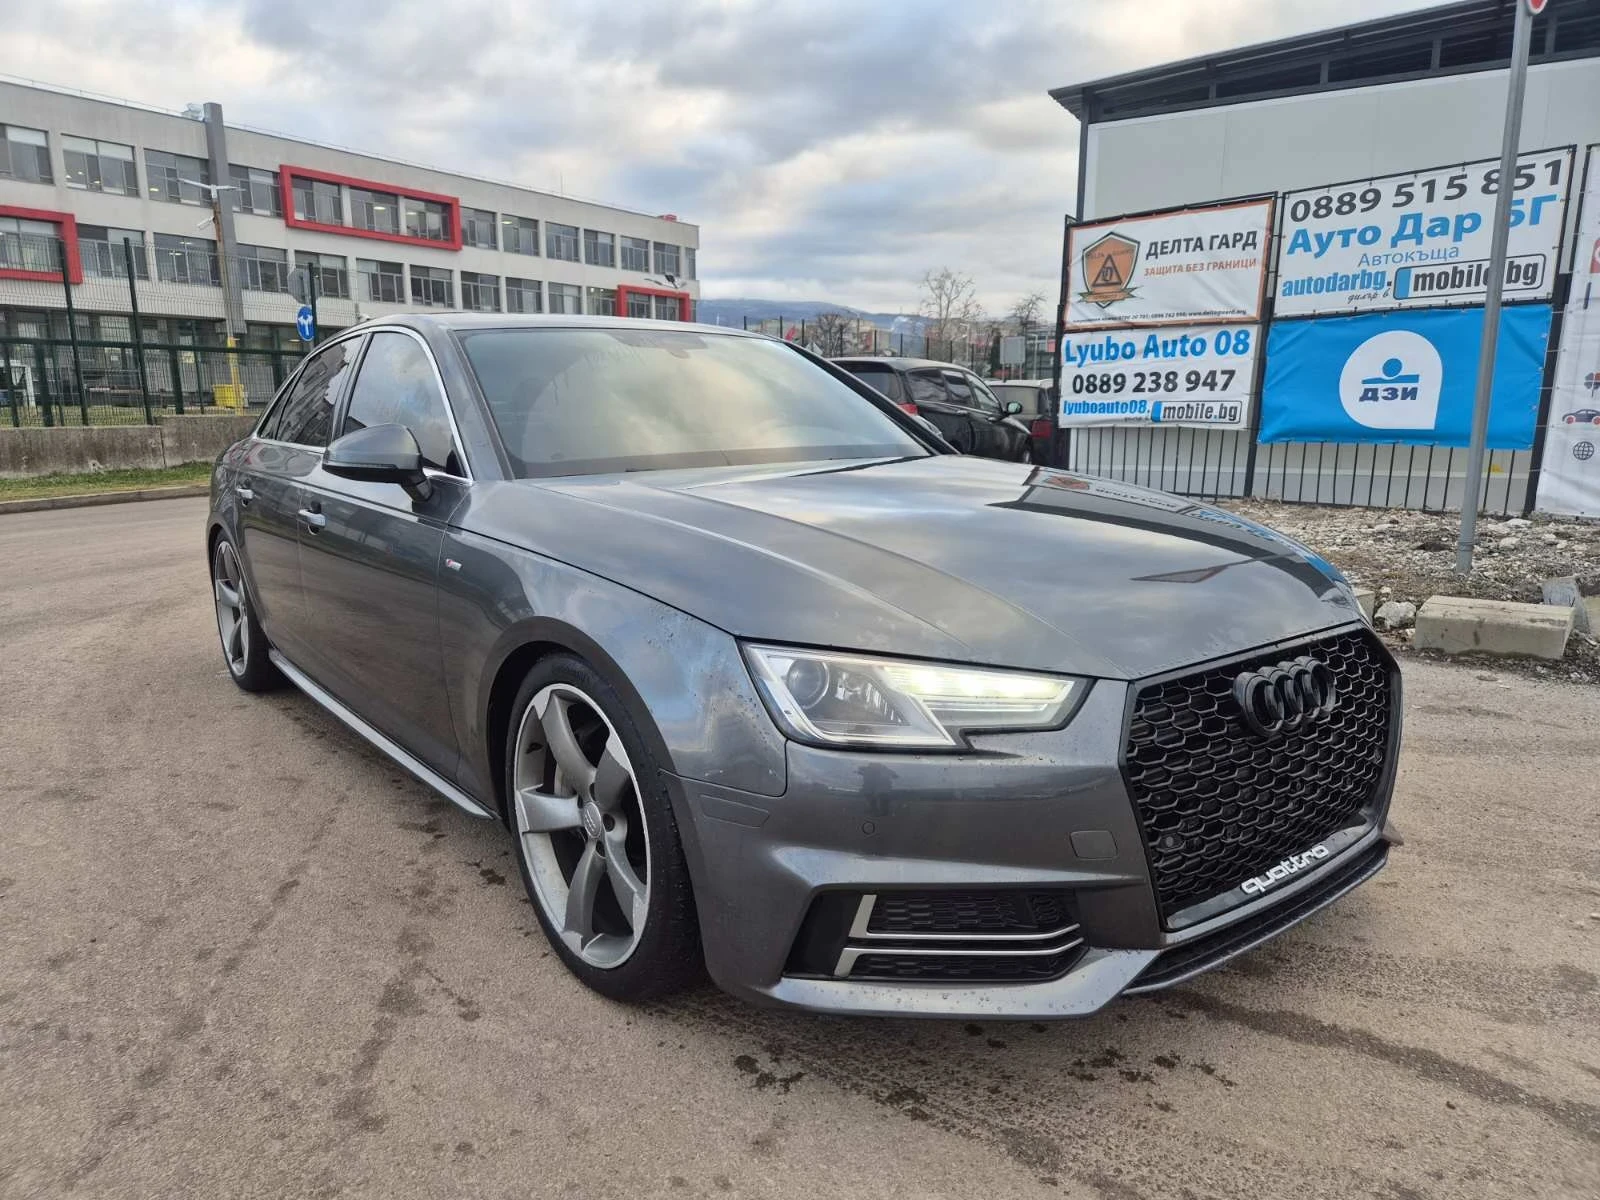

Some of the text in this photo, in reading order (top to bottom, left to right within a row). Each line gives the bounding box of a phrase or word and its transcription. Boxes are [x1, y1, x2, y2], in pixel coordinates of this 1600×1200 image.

[1290, 159, 1562, 222] 0889 515 851
[1145, 230, 1257, 260] ДЕЛТА ГАРД
[1286, 224, 1381, 258] Ауто
[1390, 212, 1482, 248] Дар
[1144, 258, 1257, 277] ЗАЩИТА БЕЗ ГРАНИЦИ
[1357, 246, 1460, 268] Автокъща
[1282, 260, 1539, 296] autodarbg. mobilebg
[1065, 329, 1251, 368] Lyubo Auto 08
[1072, 369, 1236, 394] 0889 238 947
[1358, 386, 1419, 402] ДЗИ
[1162, 402, 1239, 422] mobile.bg
[1241, 845, 1329, 894] quattro
